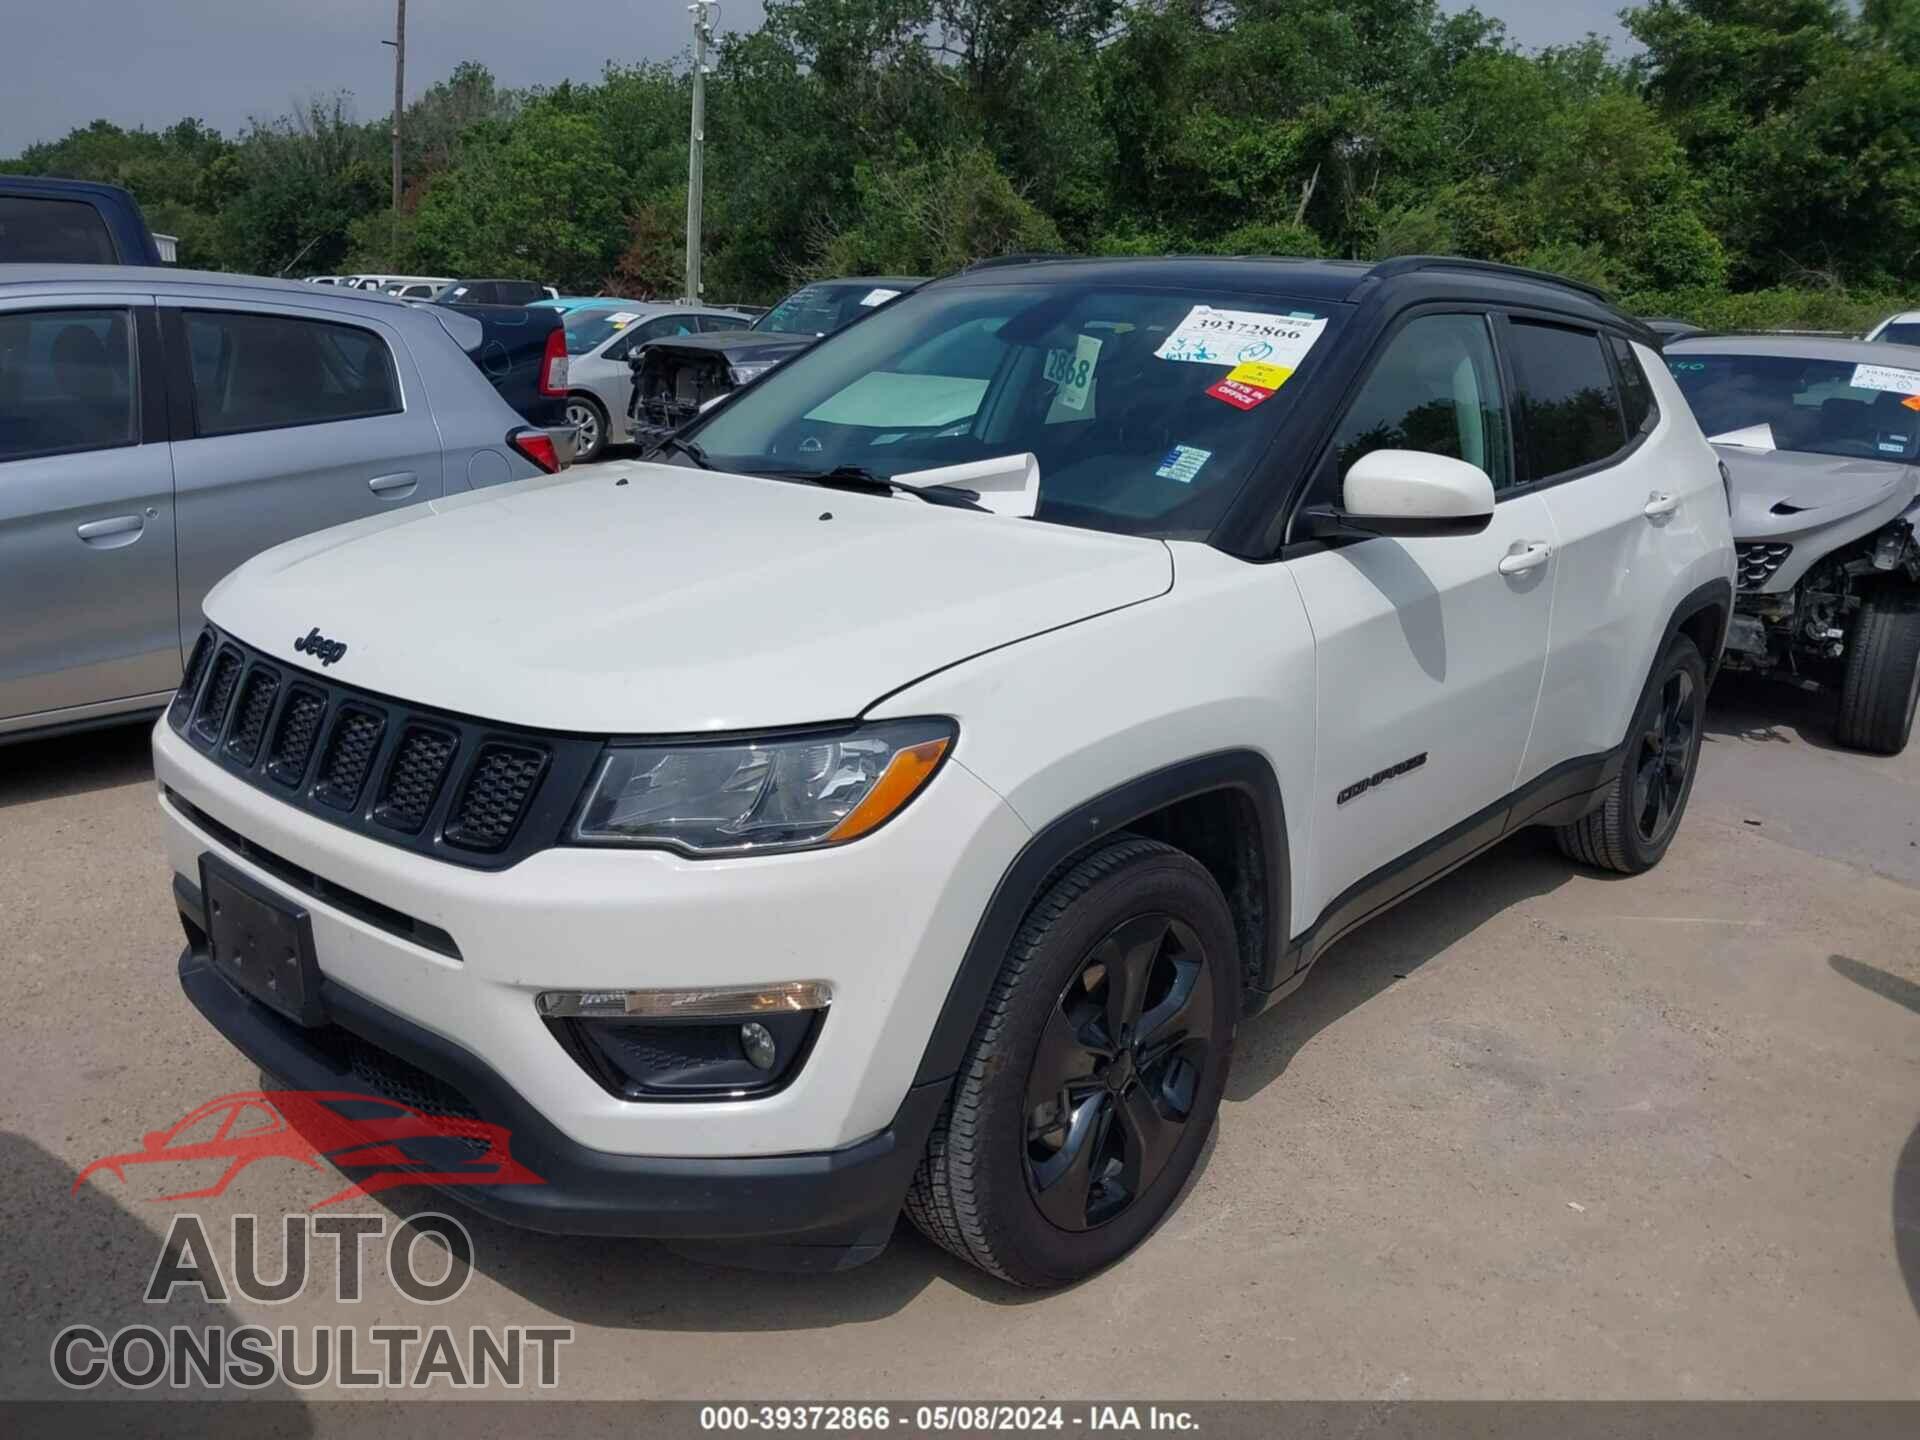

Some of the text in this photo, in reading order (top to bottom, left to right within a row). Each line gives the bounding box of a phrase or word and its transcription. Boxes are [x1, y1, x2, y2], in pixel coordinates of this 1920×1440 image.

[1194, 318, 1301, 340] 39372866
[1048, 350, 1090, 388] 2868
[1217, 386, 1255, 404] OFFICE
[1251, 390, 1265, 400] IN
[294, 627, 347, 667] Jeep
